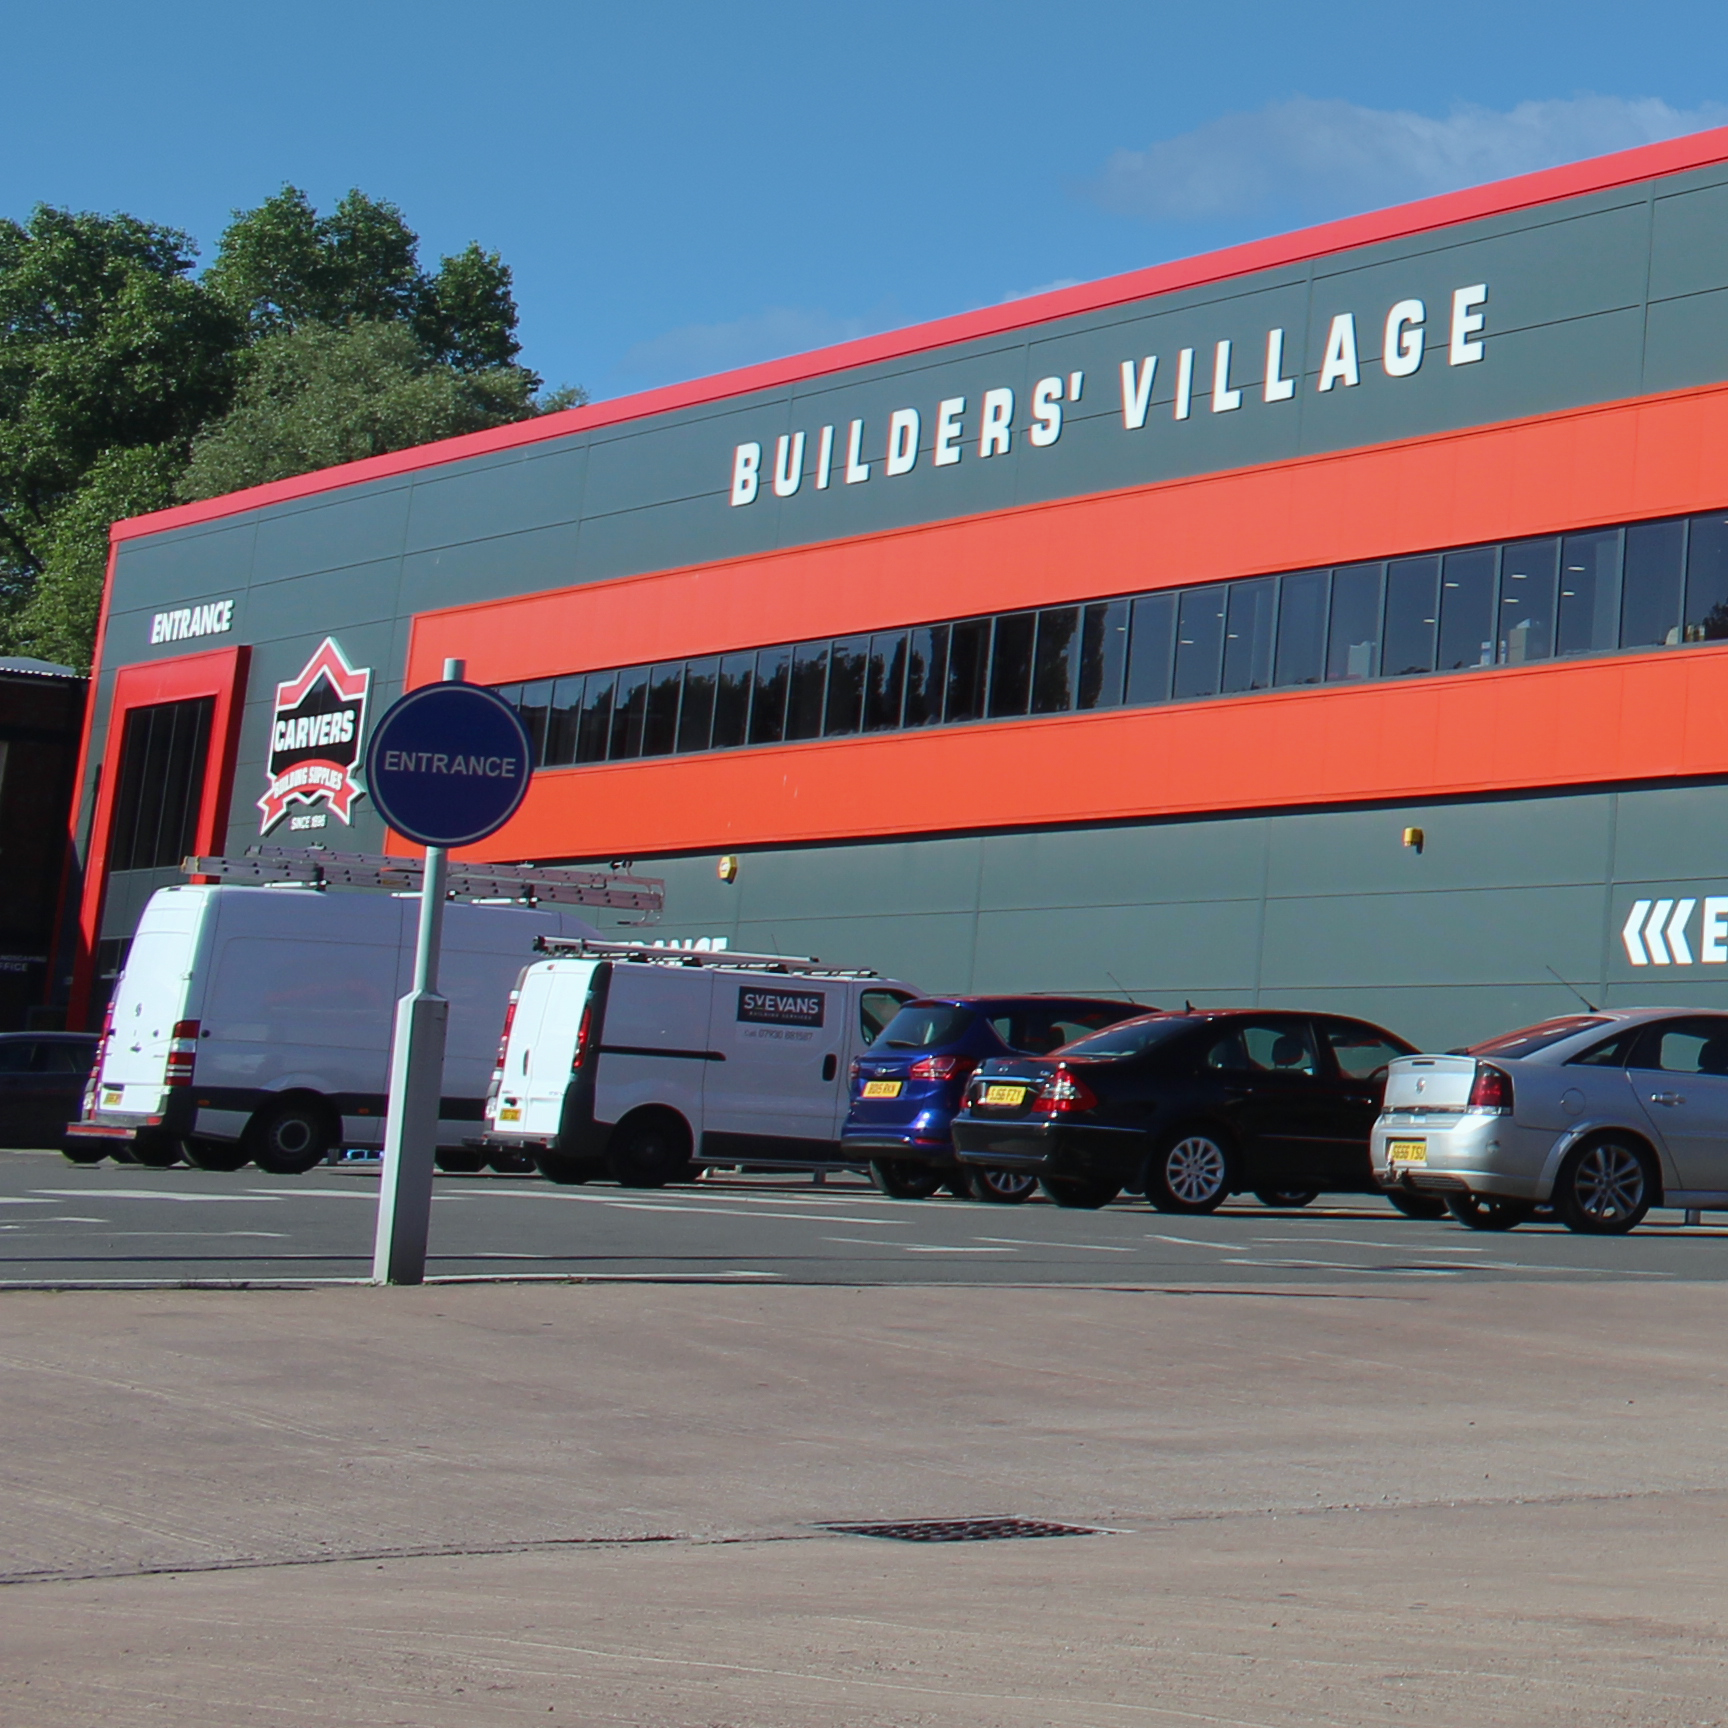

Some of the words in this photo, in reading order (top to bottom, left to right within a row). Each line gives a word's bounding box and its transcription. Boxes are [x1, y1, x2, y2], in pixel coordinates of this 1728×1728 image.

[731, 371, 1084, 507] BUILDERS'
[1120, 283, 1488, 430] VILLAGE
[149, 599, 234, 644] ENTRANCE
[274, 710, 355, 752] CARVERS
[384, 750, 516, 778] ENTRANCE
